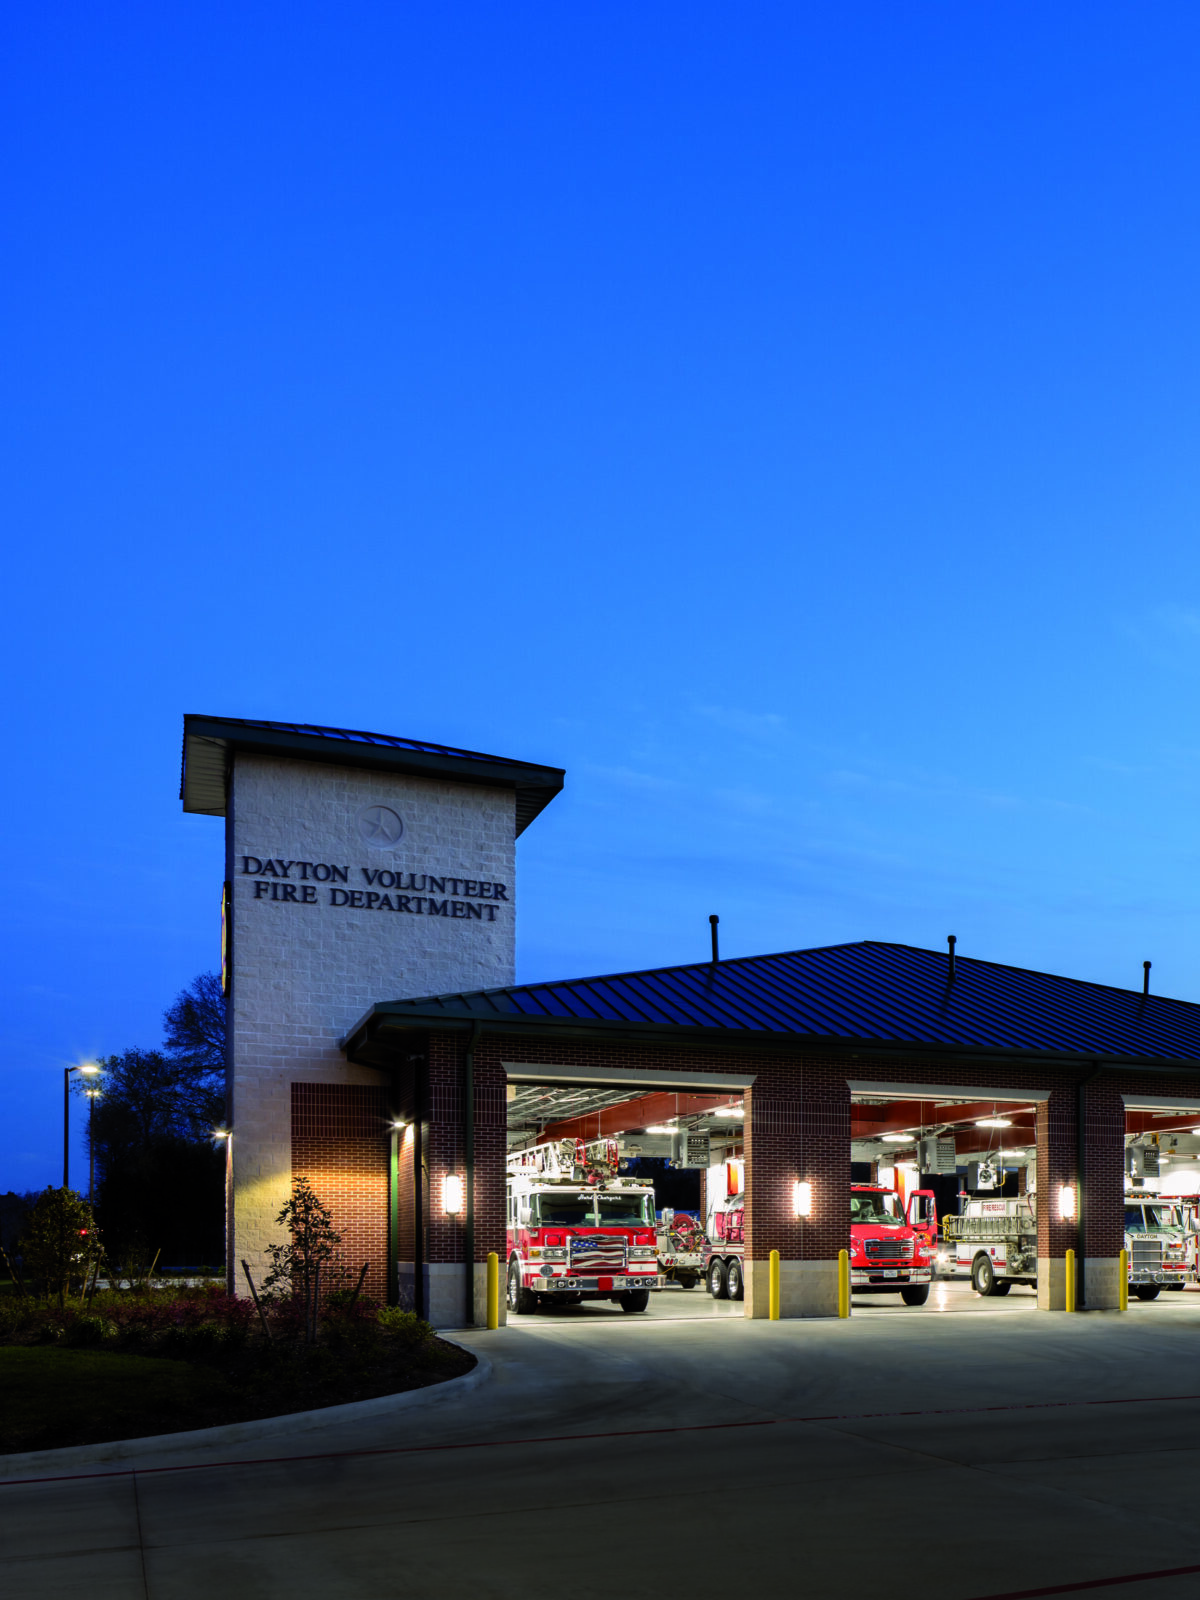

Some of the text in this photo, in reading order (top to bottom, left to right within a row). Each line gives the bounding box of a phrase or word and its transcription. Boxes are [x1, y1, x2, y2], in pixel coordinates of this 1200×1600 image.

[242, 855, 509, 901] DAYTON VOLUNTEER
[254, 880, 500, 922] FIRE DEPARTMENT
